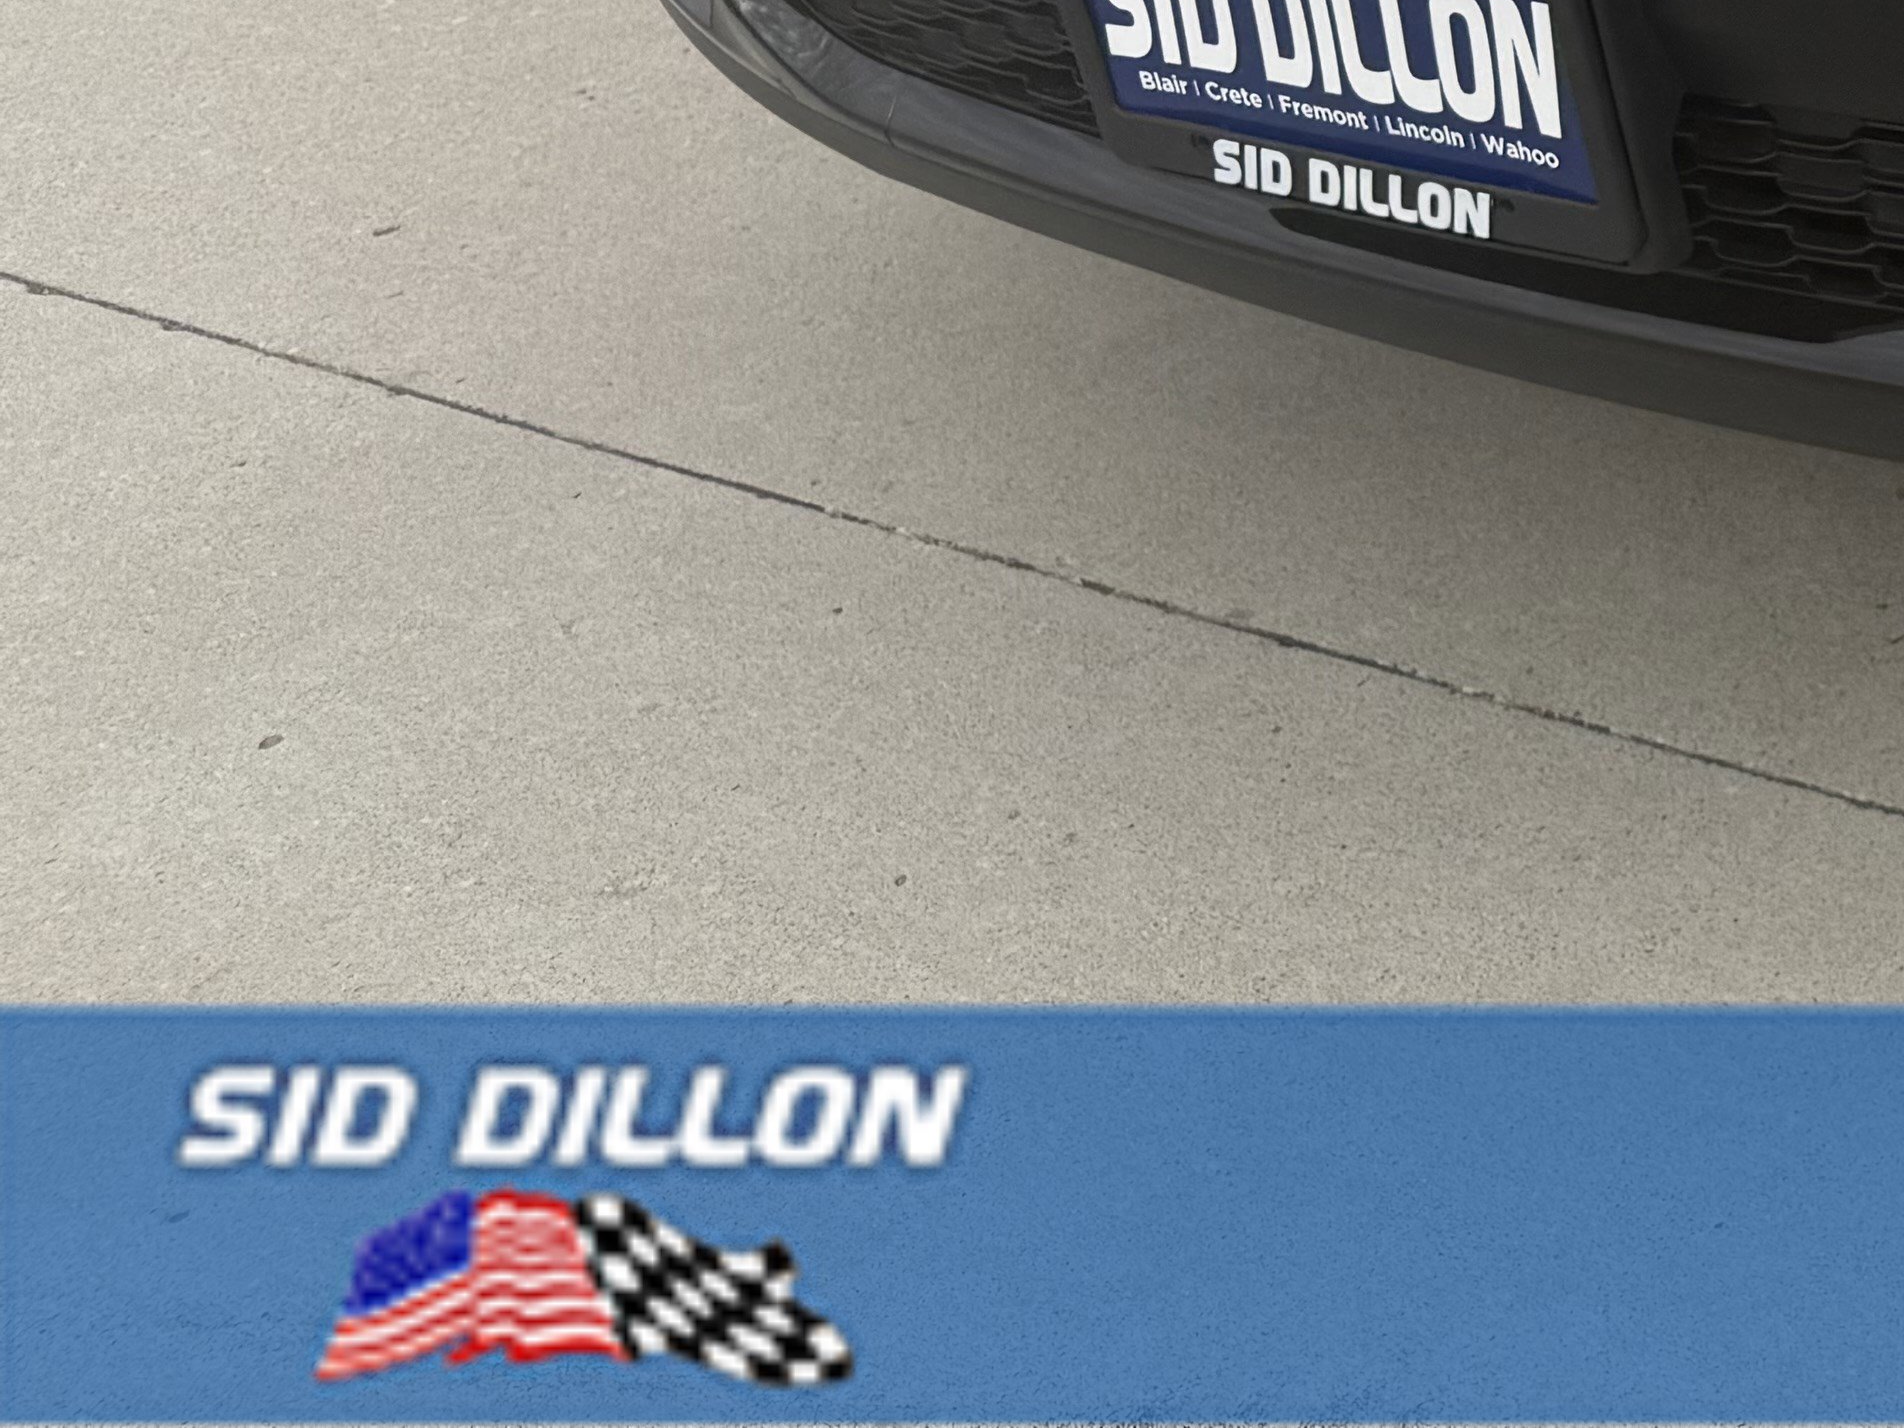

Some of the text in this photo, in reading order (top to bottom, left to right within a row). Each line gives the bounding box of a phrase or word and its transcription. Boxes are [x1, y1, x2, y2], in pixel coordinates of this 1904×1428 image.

[1138, 69, 1560, 170] Blair Crete Fremont Lincoln Wahoo
[1212, 138, 1492, 241] SID DILLON
